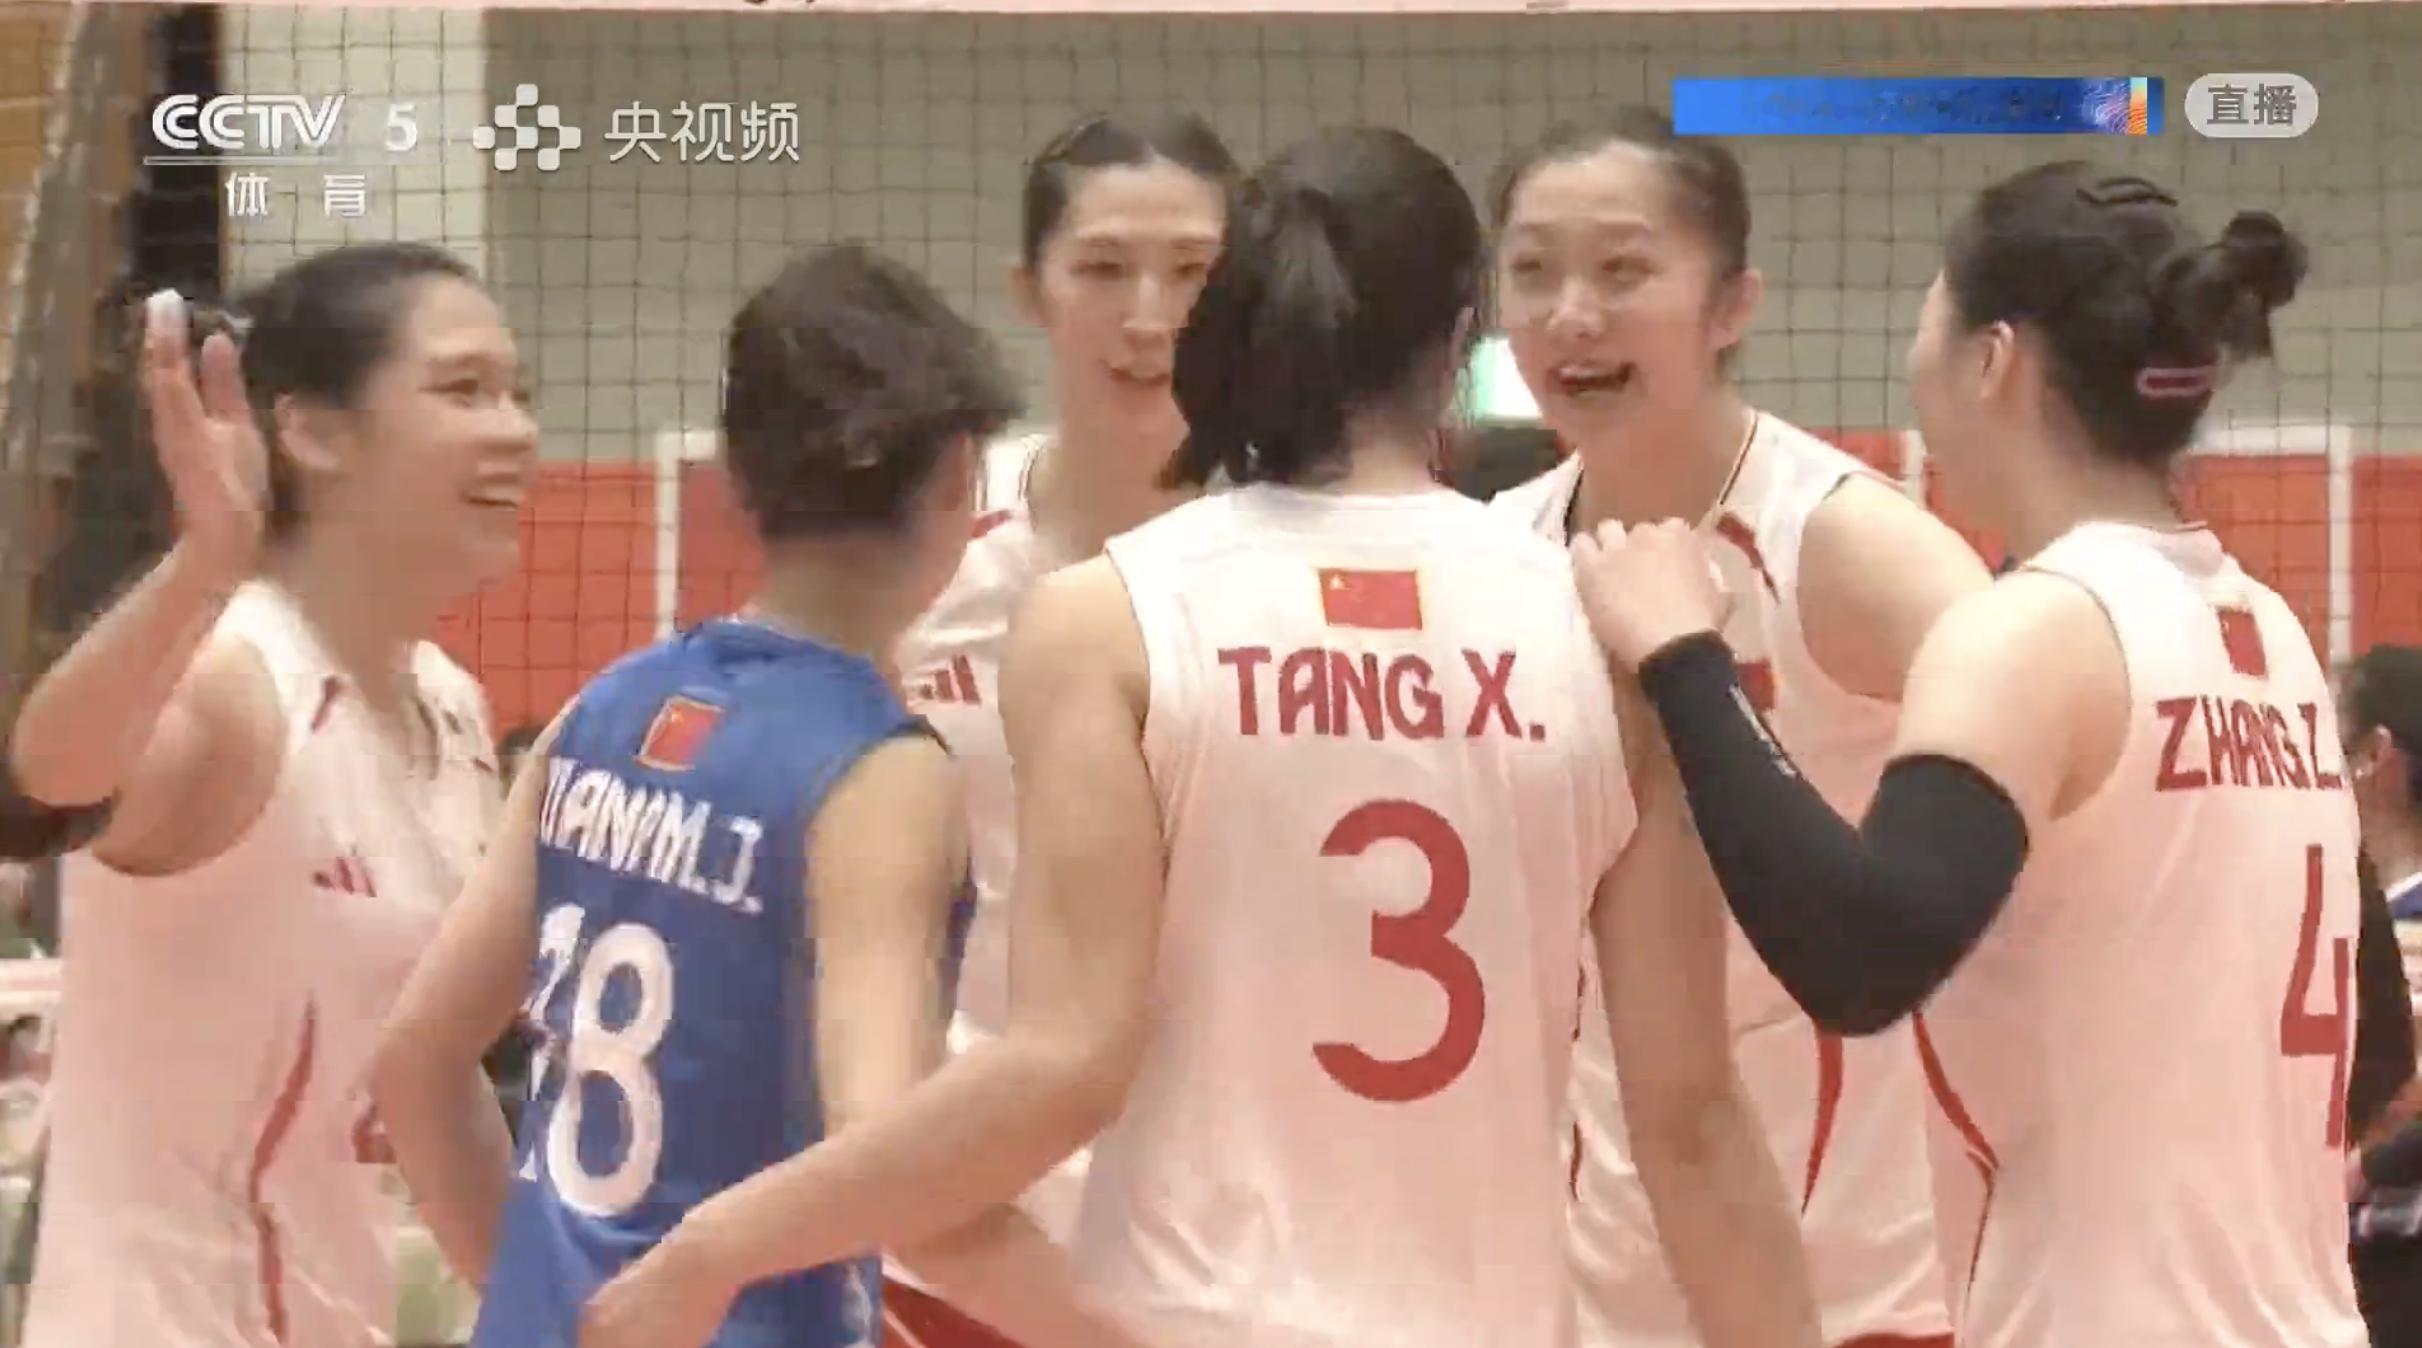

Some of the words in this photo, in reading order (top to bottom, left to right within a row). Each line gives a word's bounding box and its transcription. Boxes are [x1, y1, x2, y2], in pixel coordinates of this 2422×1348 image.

[1217, 646, 1444, 740] TANG
[1461, 648, 1546, 740] X.
[2155, 694, 2311, 790] ZHANG
[518, 902, 674, 1218] 18
[1312, 799, 1485, 1102] 3
[2281, 844, 2351, 1150] 4
